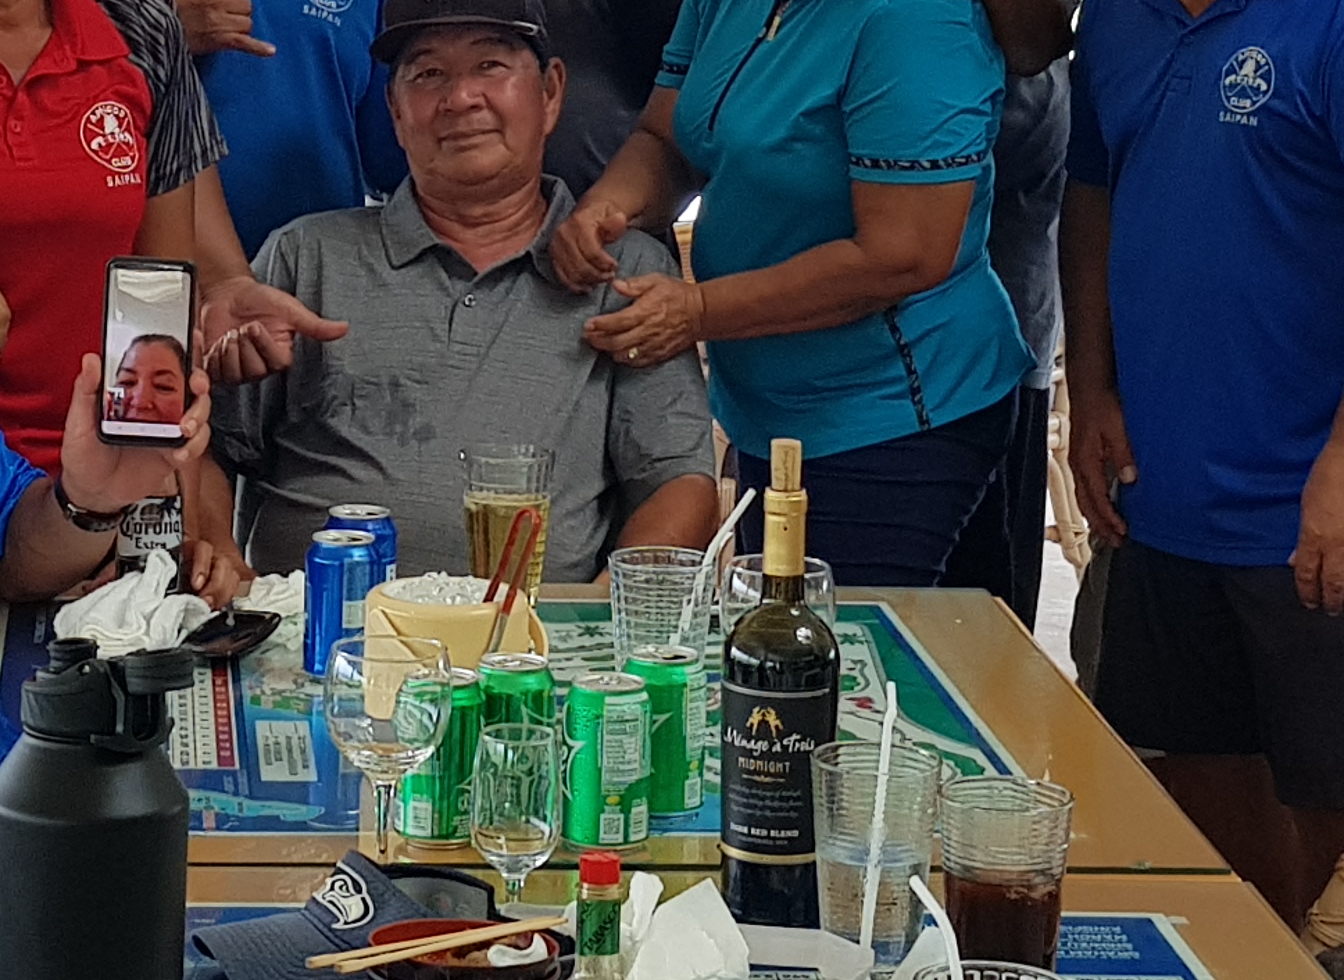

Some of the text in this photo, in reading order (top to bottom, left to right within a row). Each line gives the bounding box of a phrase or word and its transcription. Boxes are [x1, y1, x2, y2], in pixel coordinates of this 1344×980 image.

[302, 4, 341, 27] SAIPAN
[1229, 96, 1253, 108] CLUB
[1218, 111, 1259, 127] SAIPAN
[111, 156, 133, 168] CLUB
[106, 173, 142, 188] SAIPAN
[120, 509, 180, 540] Corona
[134, 537, 167, 550] Extra
[771, 738, 782, 753] à
[783, 732, 815, 754] Trois
[737, 756, 791, 773] MIDNIGHT
[750, 827, 768, 837] RED
[769, 829, 799, 837] BLEND
